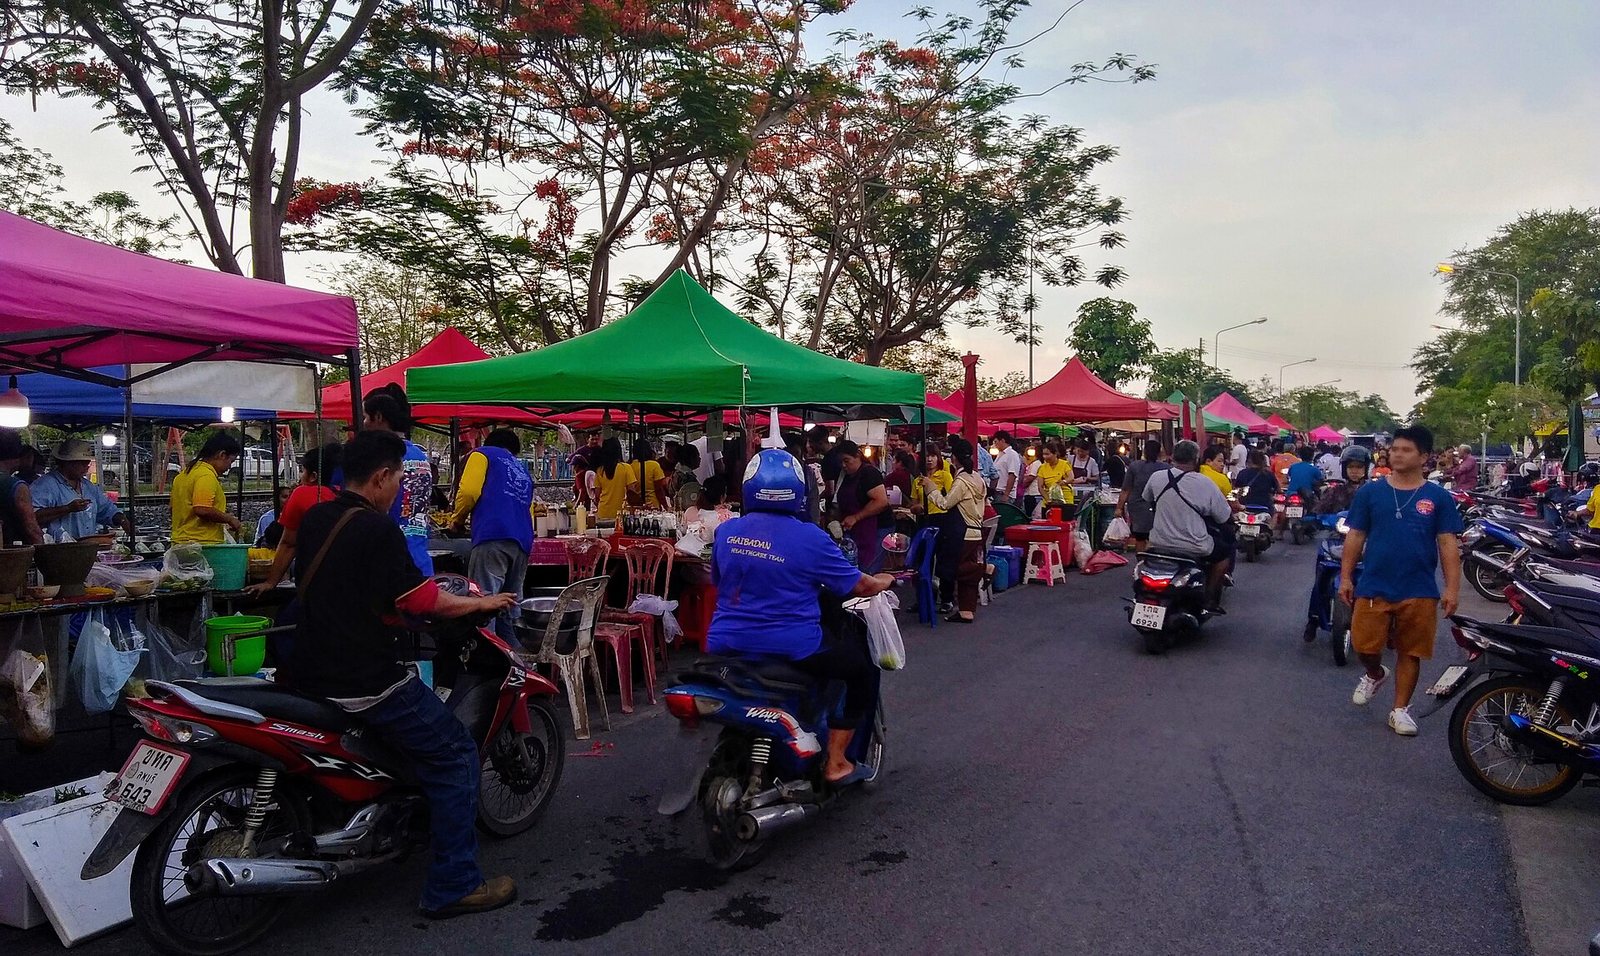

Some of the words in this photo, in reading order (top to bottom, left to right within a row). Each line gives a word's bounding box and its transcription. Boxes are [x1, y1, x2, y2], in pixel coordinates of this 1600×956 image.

[726, 536, 771, 549] CHAIBADAN
[731, 548, 767, 559] HEALTHCARE
[768, 554, 785, 563] TEAM
[268, 722, 325, 740] Smash
[121, 783, 151, 804] 643
